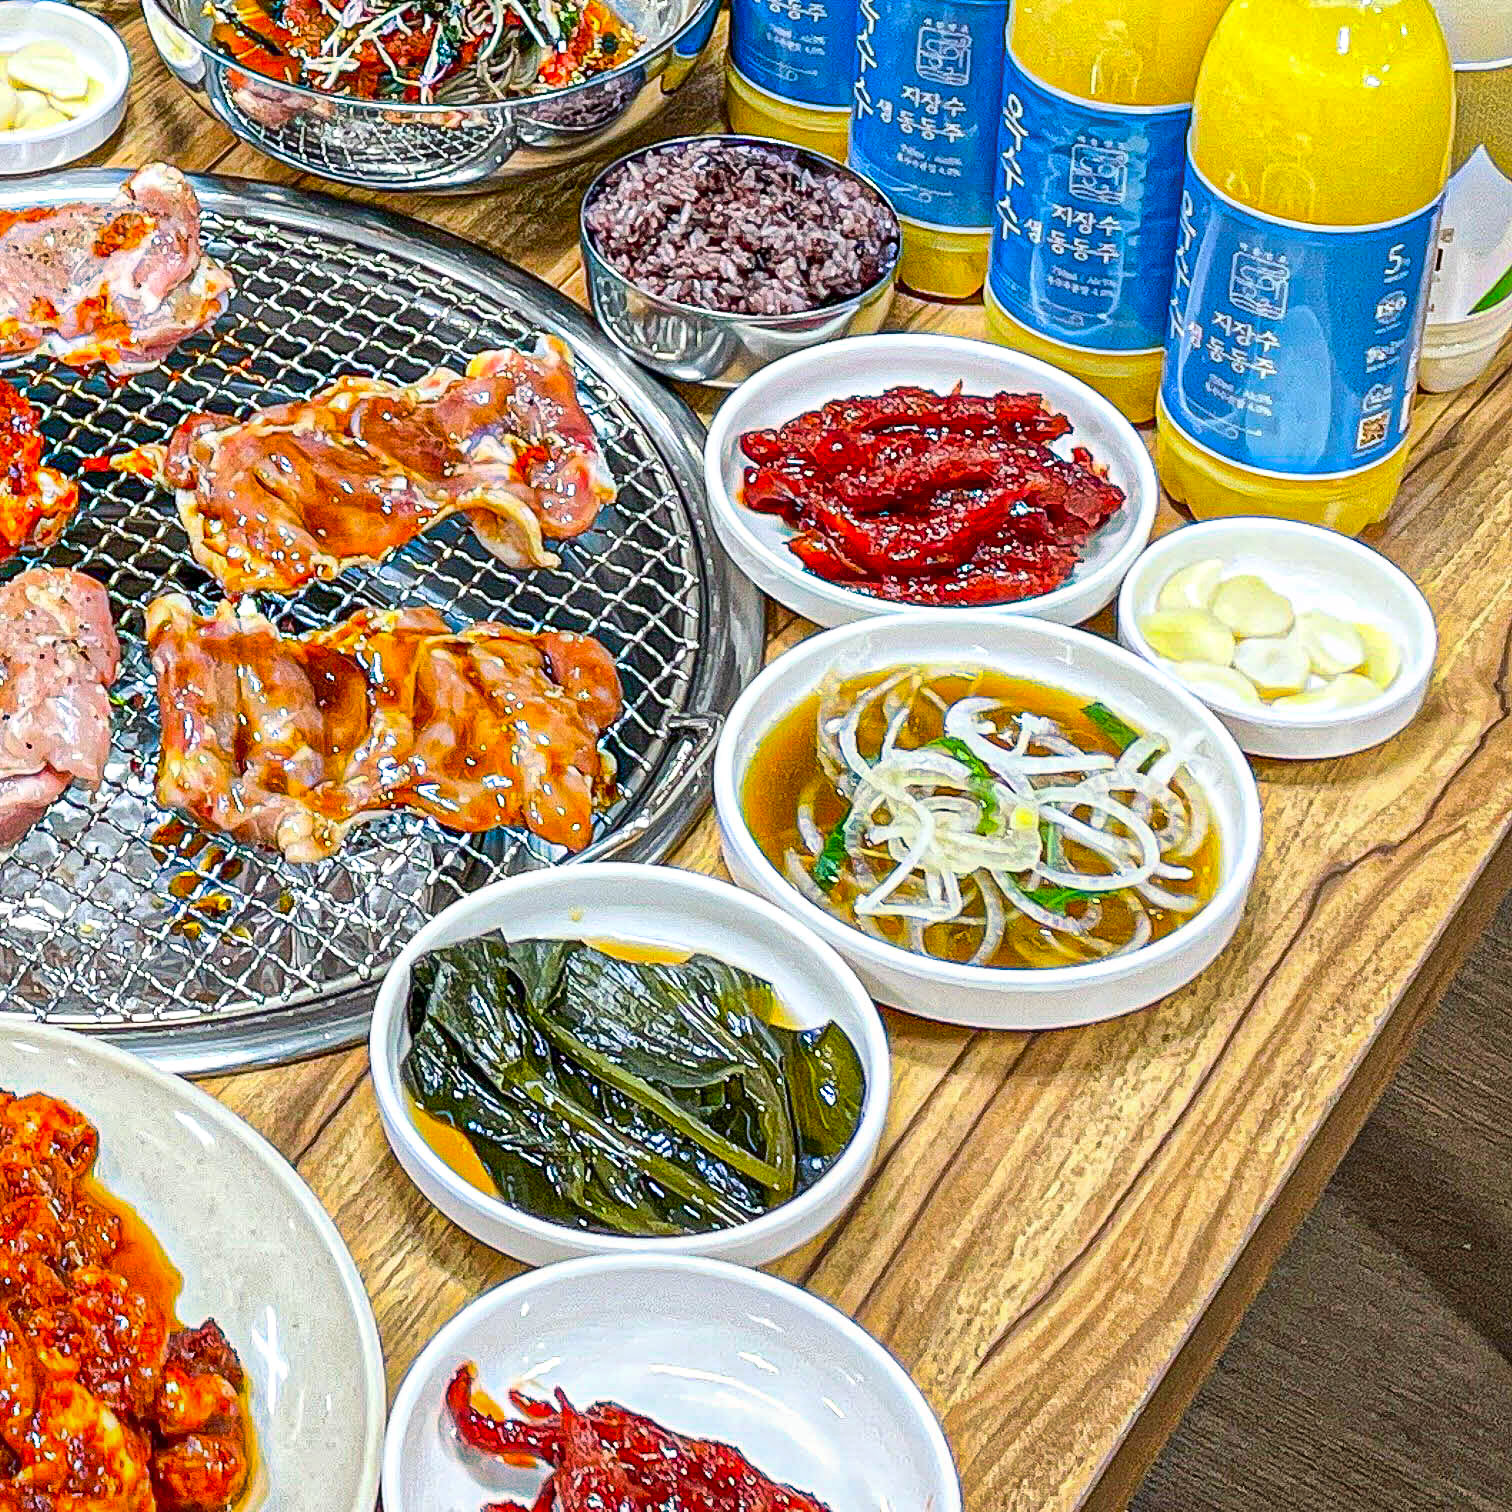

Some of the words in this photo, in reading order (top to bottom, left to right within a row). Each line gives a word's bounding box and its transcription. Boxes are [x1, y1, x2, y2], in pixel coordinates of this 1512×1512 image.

[901, 85, 967, 118] 지장수
[1051, 203, 1123, 237] 지장수
[1211, 311, 1281, 353] 지장수
